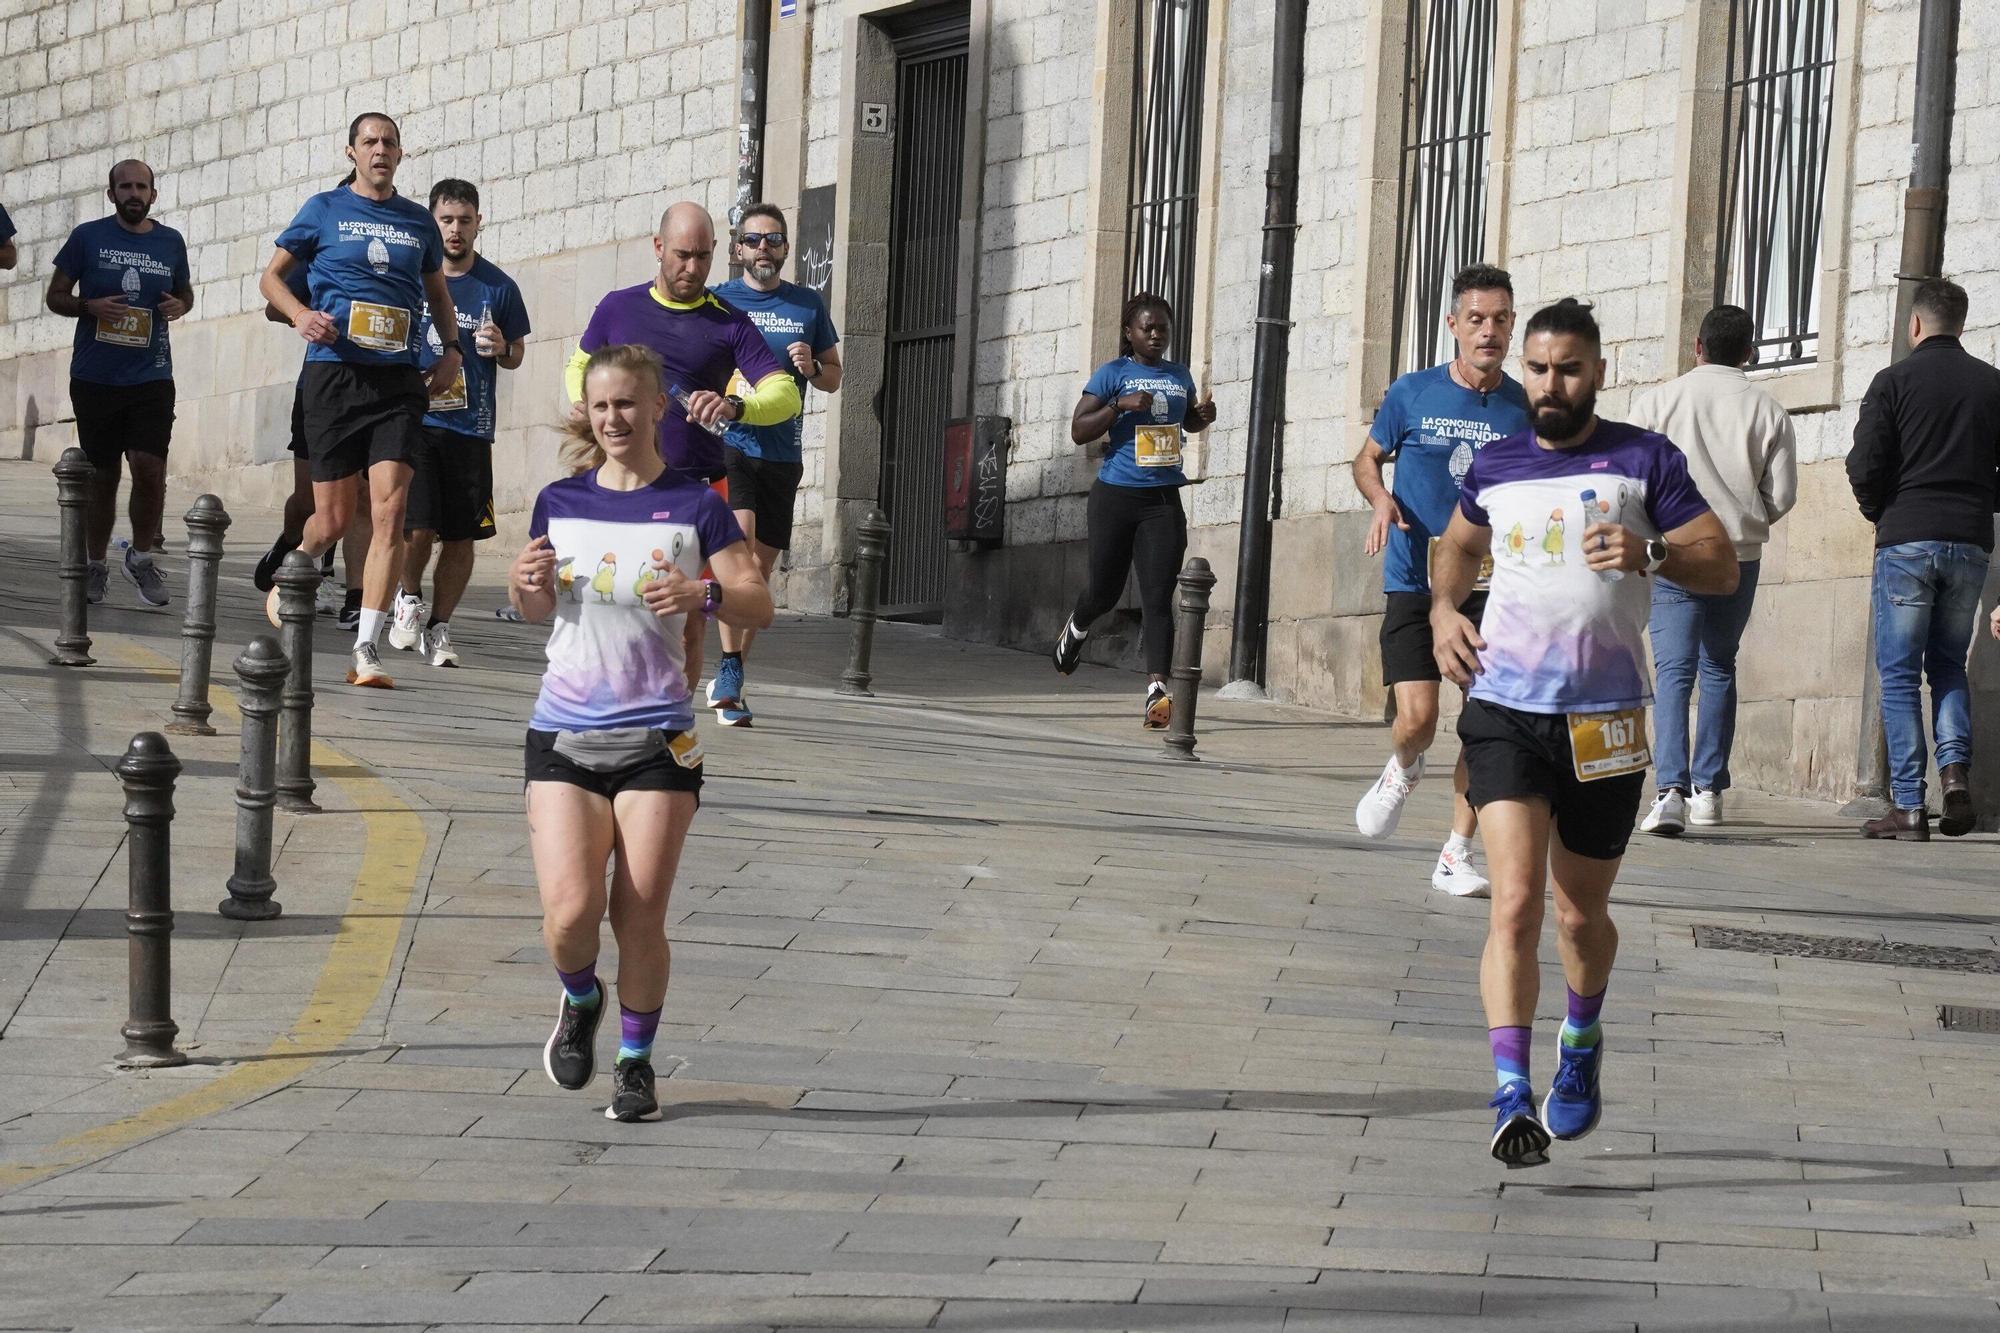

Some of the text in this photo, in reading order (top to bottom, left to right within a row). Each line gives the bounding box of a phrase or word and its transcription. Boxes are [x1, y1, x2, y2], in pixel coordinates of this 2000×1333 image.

[349, 222, 395, 231] CONQUISTA
[352, 228, 411, 240] ALMENDRA
[109, 249, 151, 260] CONQUISTA
[111, 256, 163, 269] ALMENDRA
[368, 316, 395, 335] 153
[764, 326, 804, 334] KONKISTA
[1435, 418, 1491, 431] CONQUISTA
[1153, 436, 1173, 450] 112
